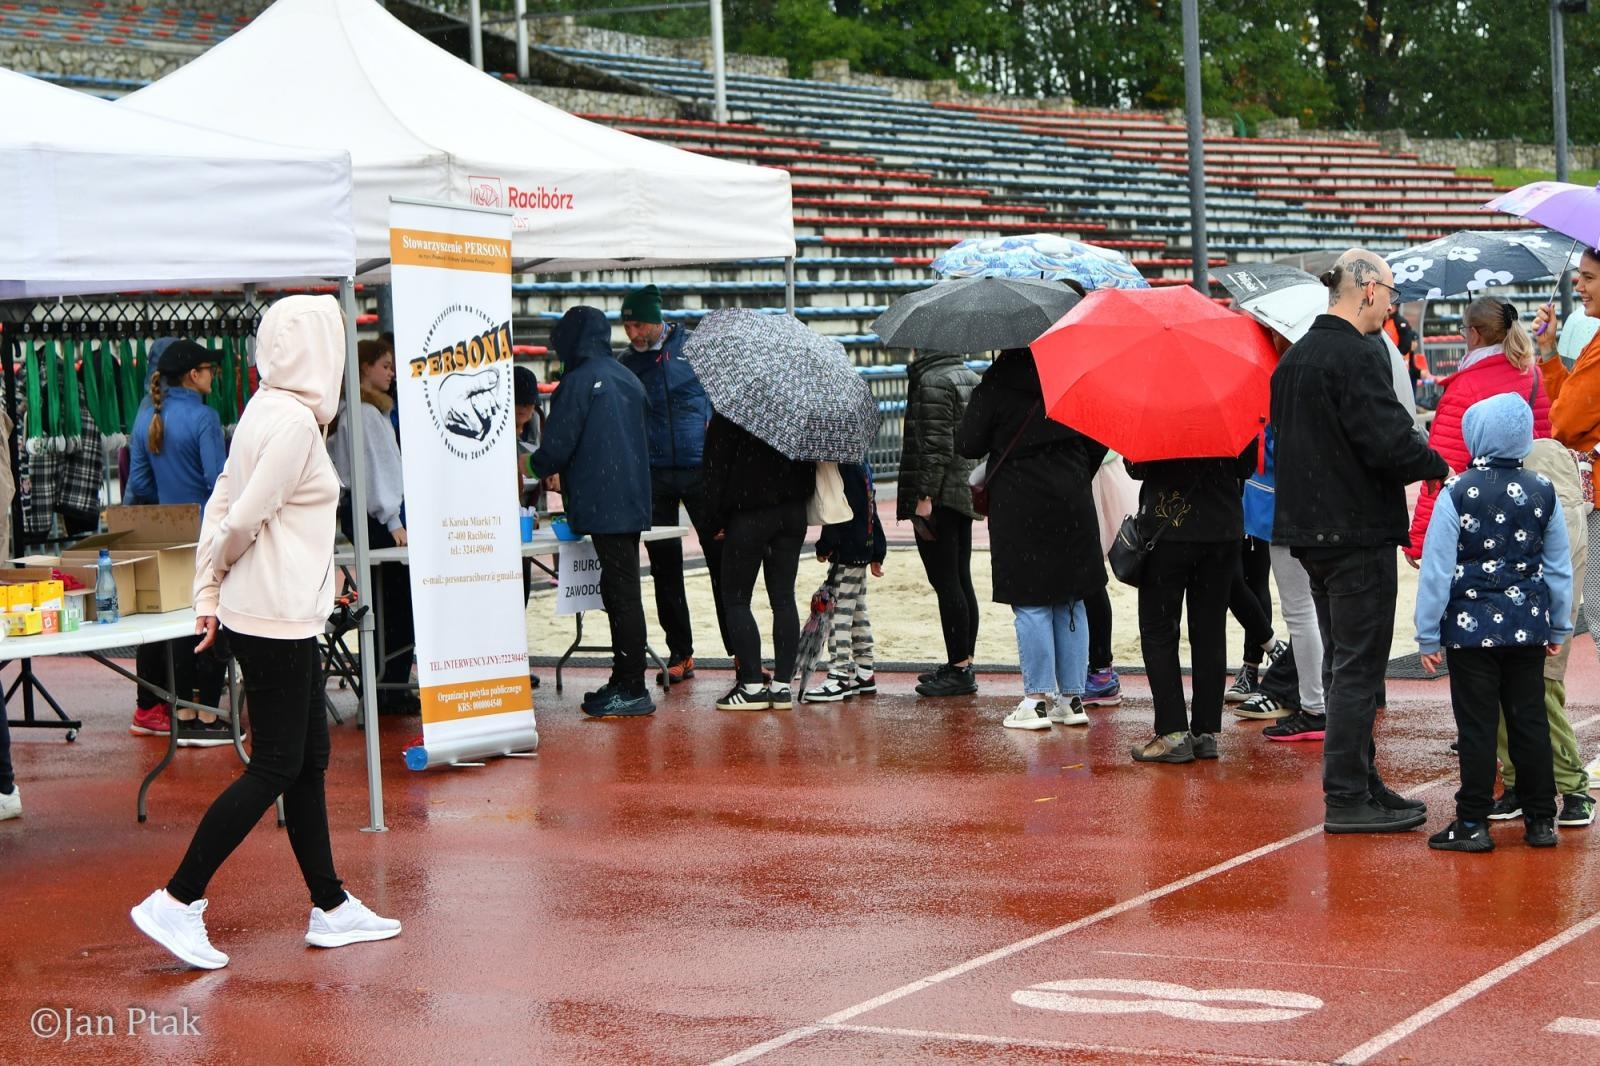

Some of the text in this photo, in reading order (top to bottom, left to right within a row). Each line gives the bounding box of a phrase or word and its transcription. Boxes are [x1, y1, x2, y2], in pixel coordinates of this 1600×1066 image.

[508, 187, 574, 210] Racibórz
[402, 235, 508, 258] Stowarzyszenie PERSONA
[409, 320, 514, 379] PERSONA
[573, 558, 602, 573] BIURO
[437, 689, 469, 703] Organizacja
[490, 684, 522, 698] publicznego
[457, 702, 473, 713] KRS:
